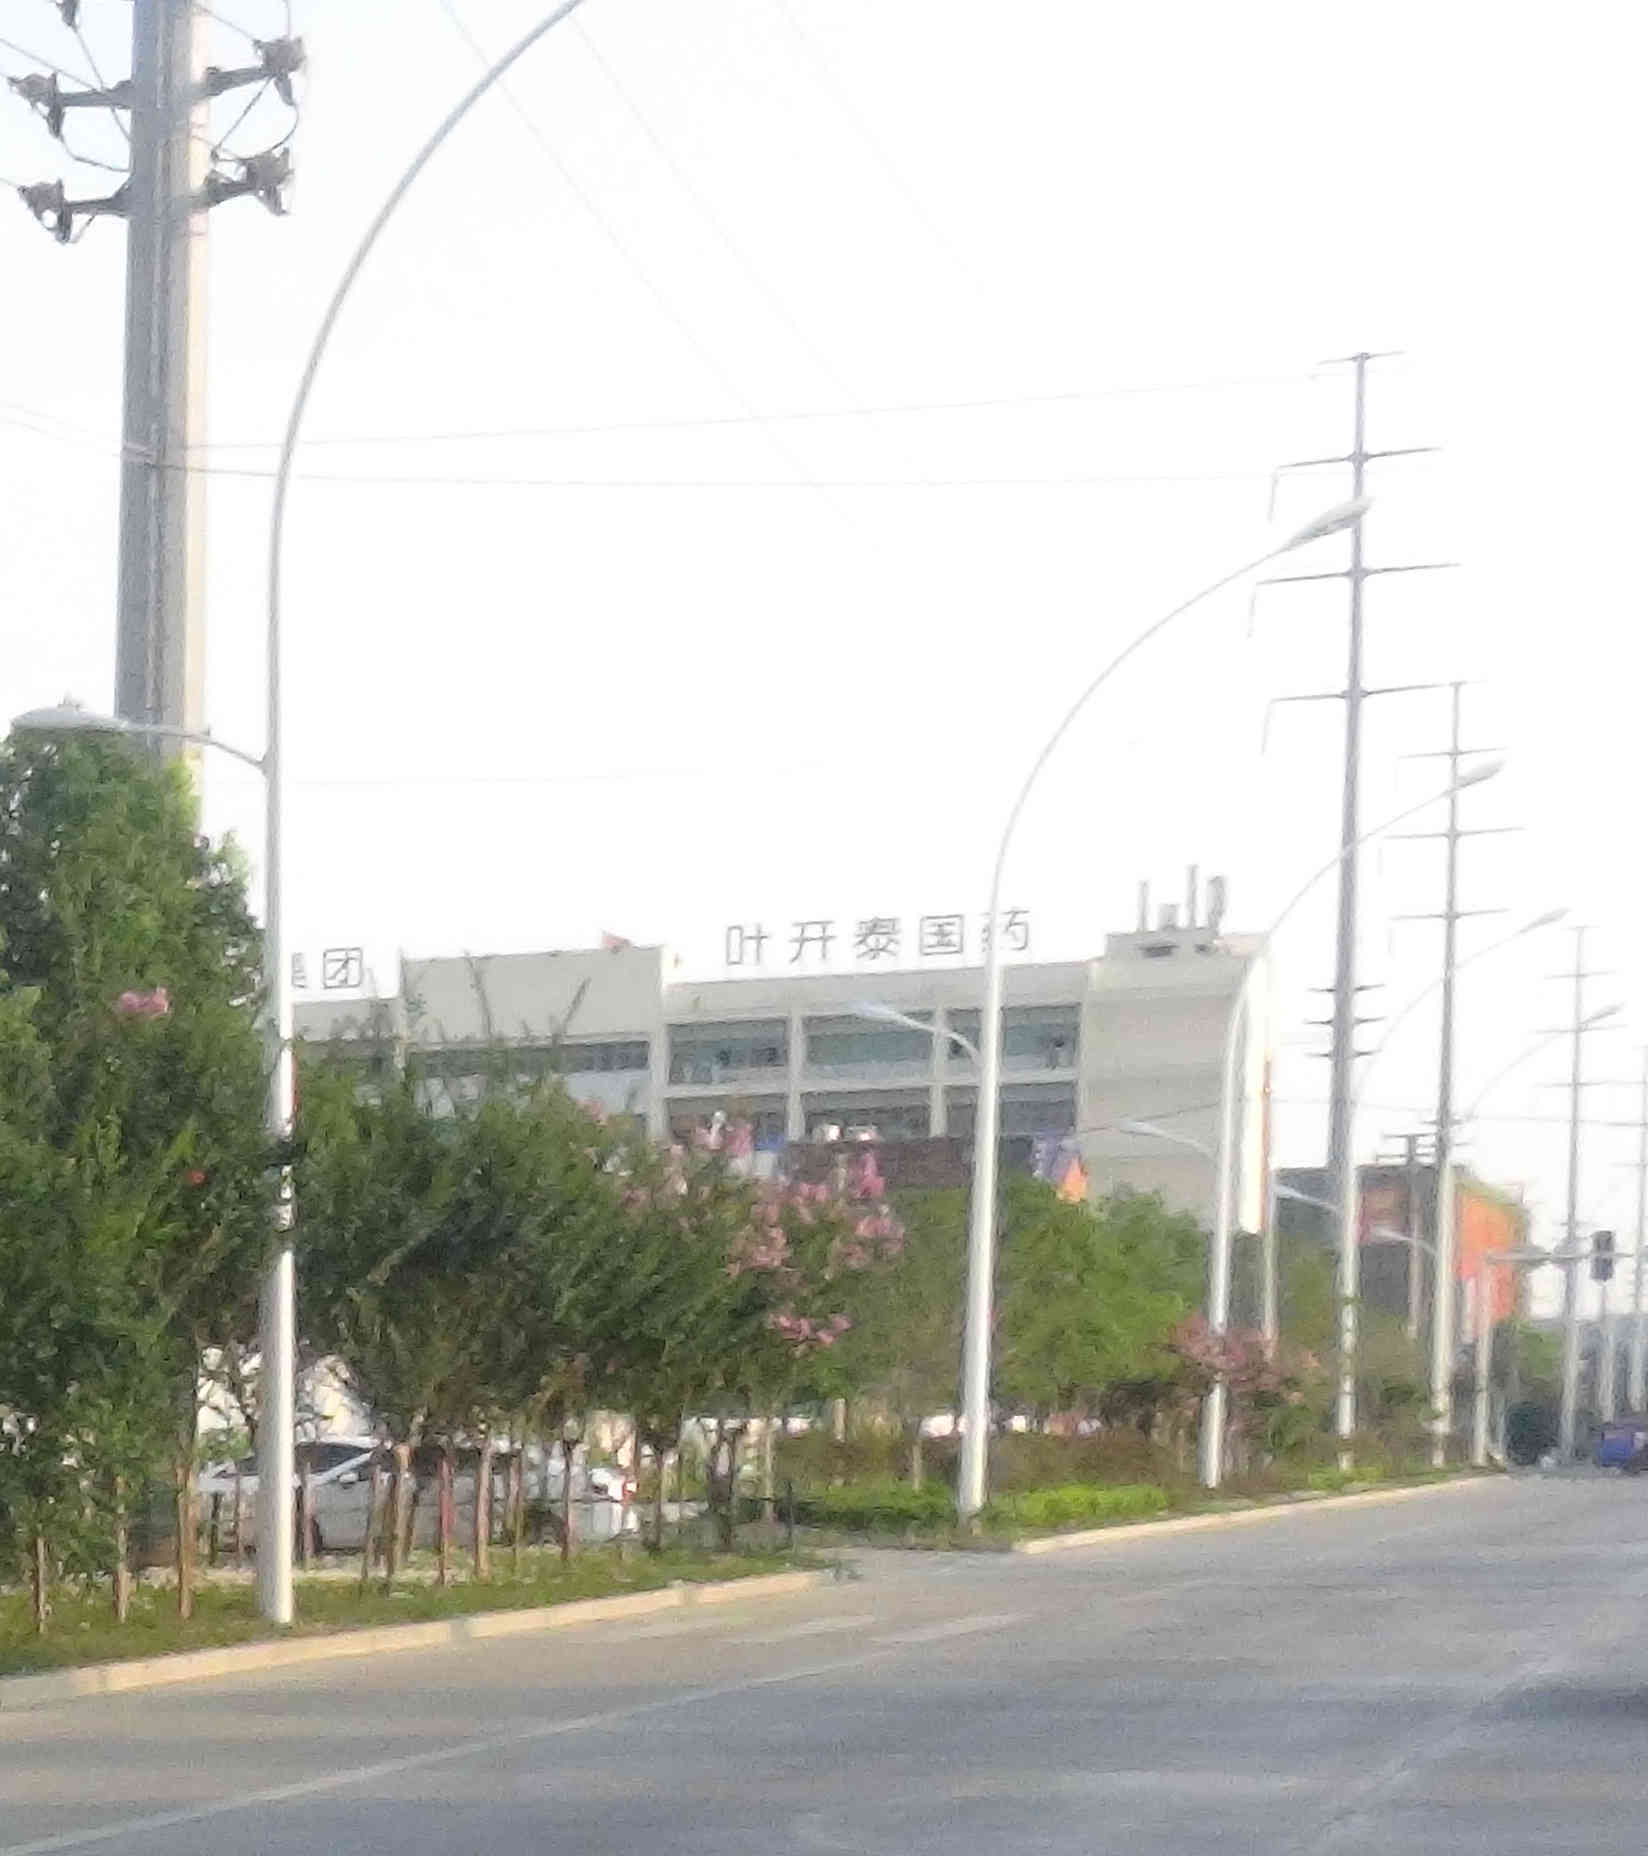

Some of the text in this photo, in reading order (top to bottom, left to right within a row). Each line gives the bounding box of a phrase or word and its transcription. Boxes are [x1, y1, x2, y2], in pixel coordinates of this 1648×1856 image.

[725, 906, 1031, 966] 叶开泰国药
